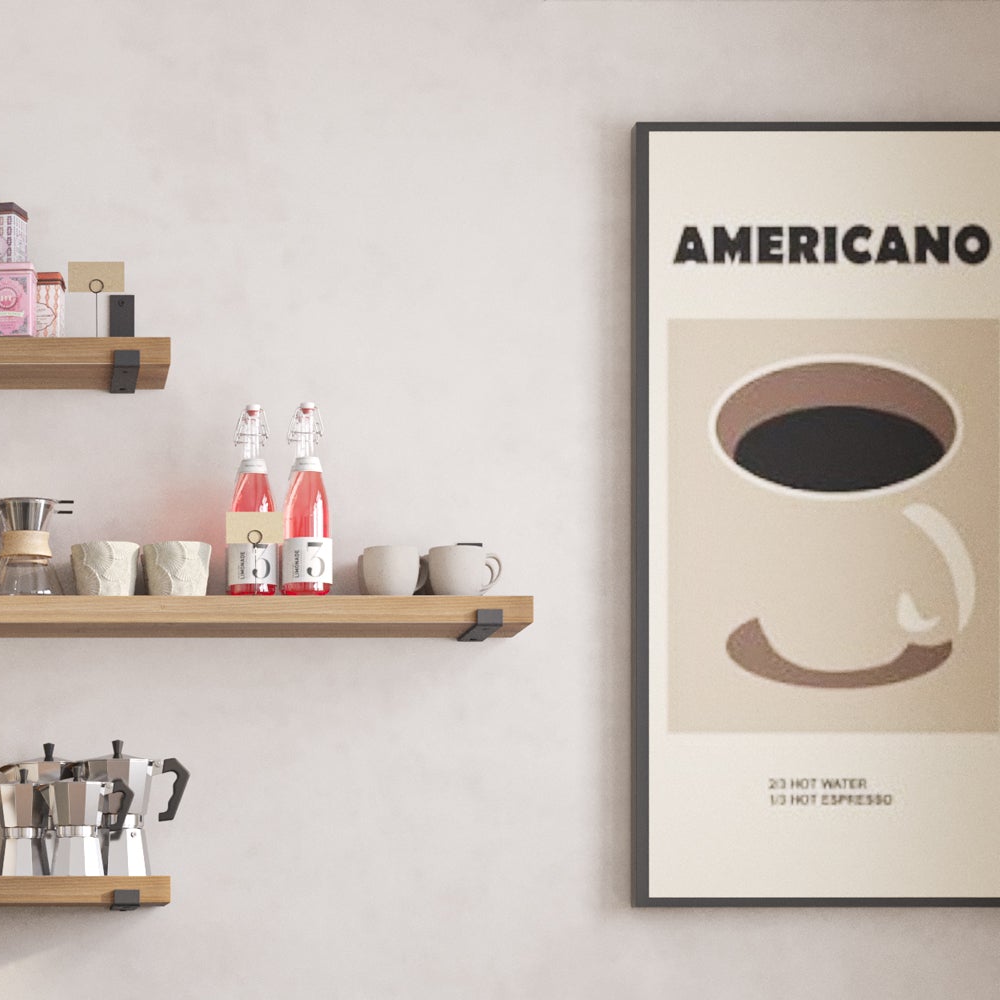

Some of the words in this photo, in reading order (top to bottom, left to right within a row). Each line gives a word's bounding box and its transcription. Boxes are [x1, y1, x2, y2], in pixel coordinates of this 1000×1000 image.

[673, 224, 991, 265] AMERICANO
[790, 777, 817, 790] HOT
[820, 777, 868, 790] WATER
[790, 793, 817, 806] HOT
[820, 793, 892, 807] ESPRESSO
